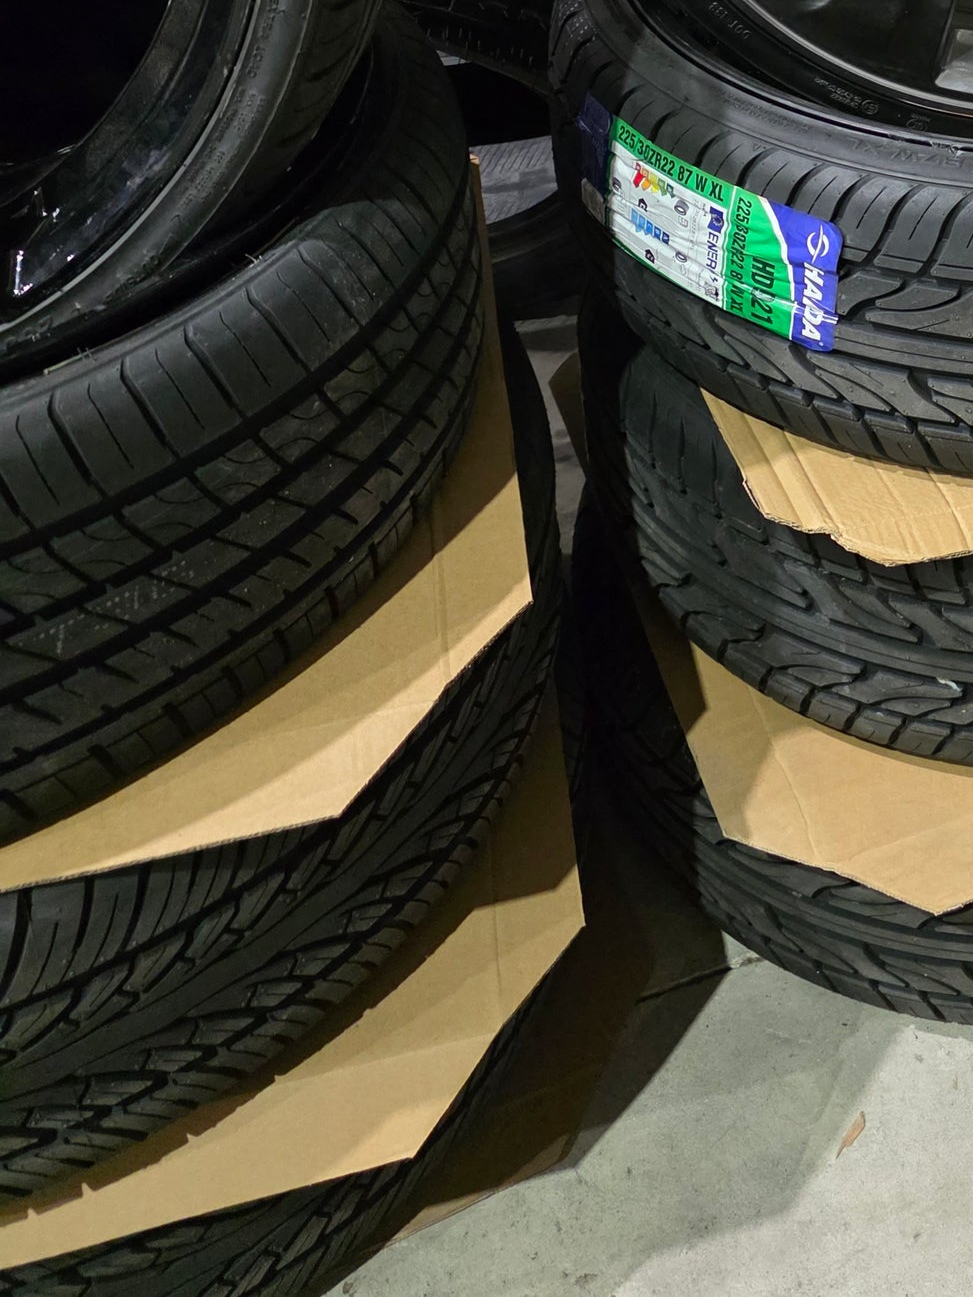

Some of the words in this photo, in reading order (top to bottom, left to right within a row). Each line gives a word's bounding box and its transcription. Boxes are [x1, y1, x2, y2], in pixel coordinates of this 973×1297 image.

[618, 125, 676, 177] 225/30ZR22
[677, 165, 693, 185] 87
[695, 173, 708, 193] W
[709, 182, 724, 202] XL
[801, 261, 826, 342] HAIDA
